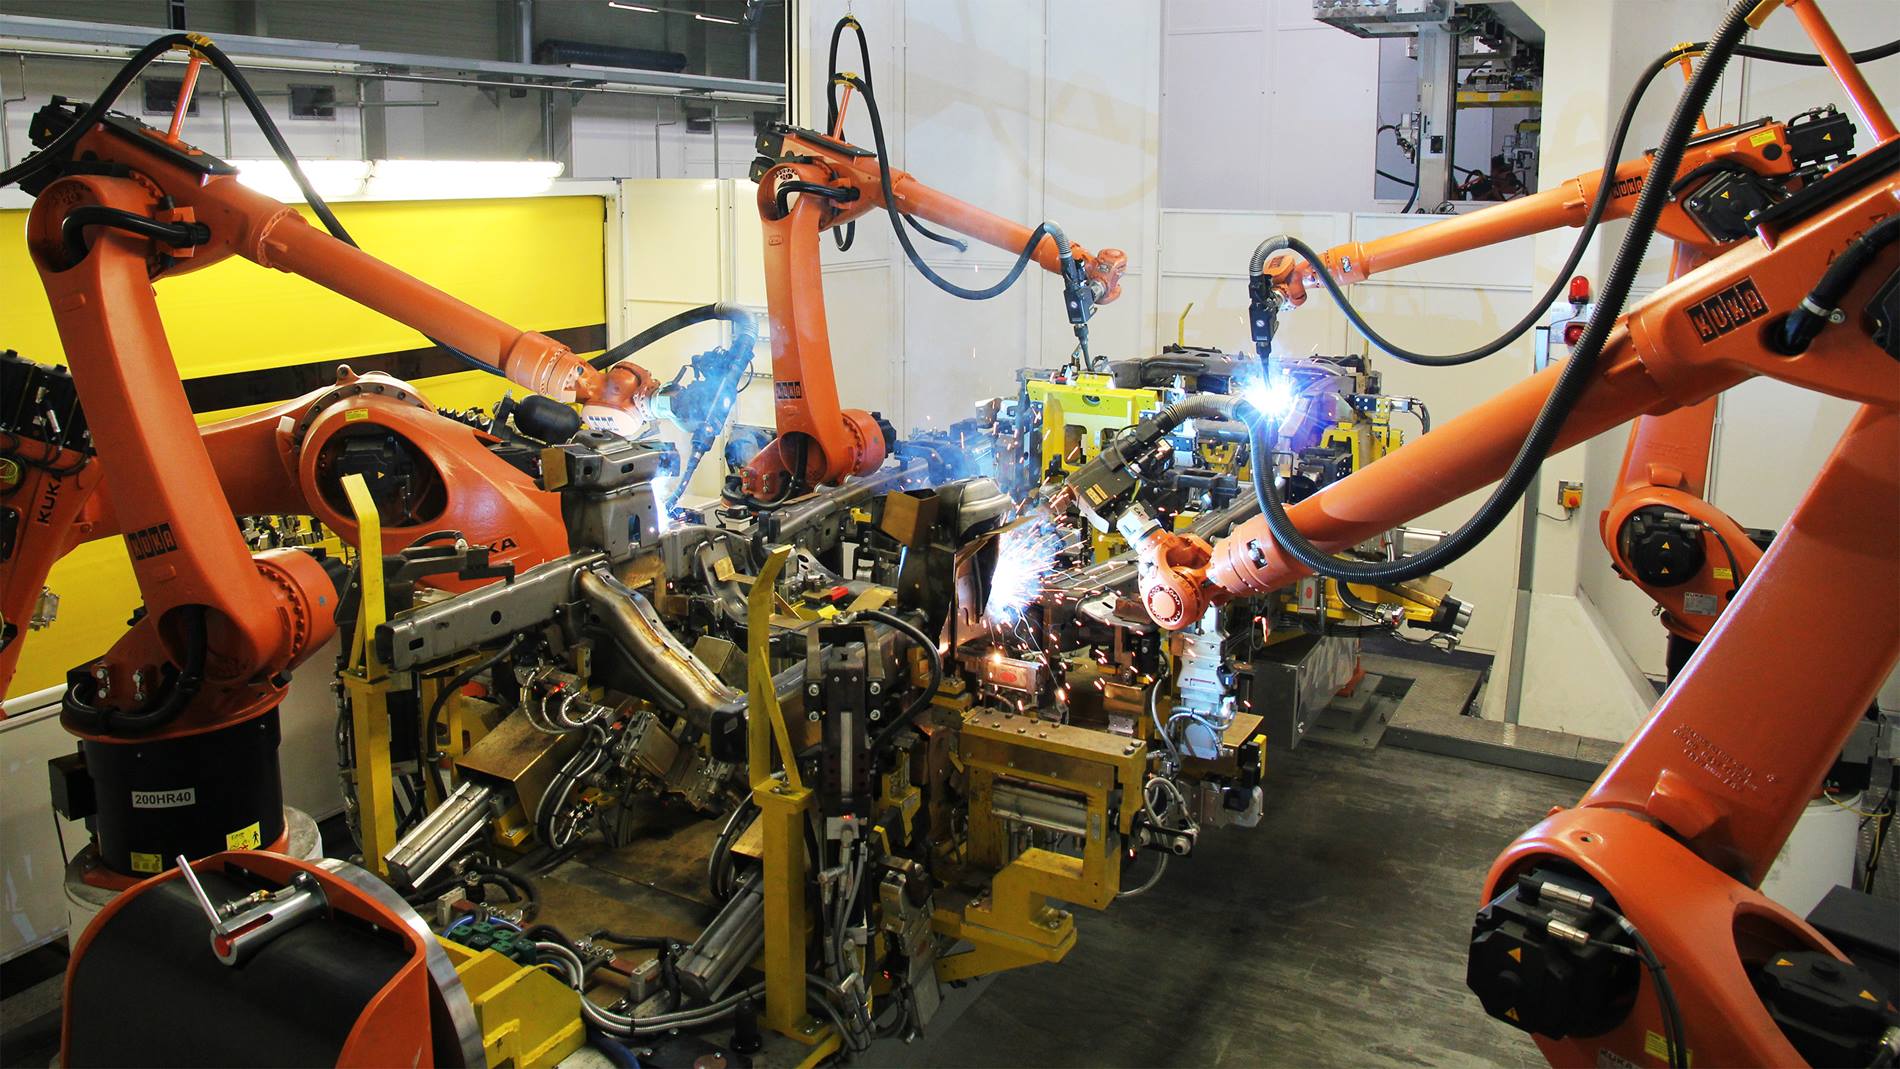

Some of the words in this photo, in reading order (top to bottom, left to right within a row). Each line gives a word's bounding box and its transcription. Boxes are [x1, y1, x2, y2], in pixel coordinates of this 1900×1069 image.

[1690, 282, 1767, 341] KUKA
[36, 475, 62, 524] KUK
[128, 525, 177, 560] KUKA
[135, 792, 191, 804] 200HR40
